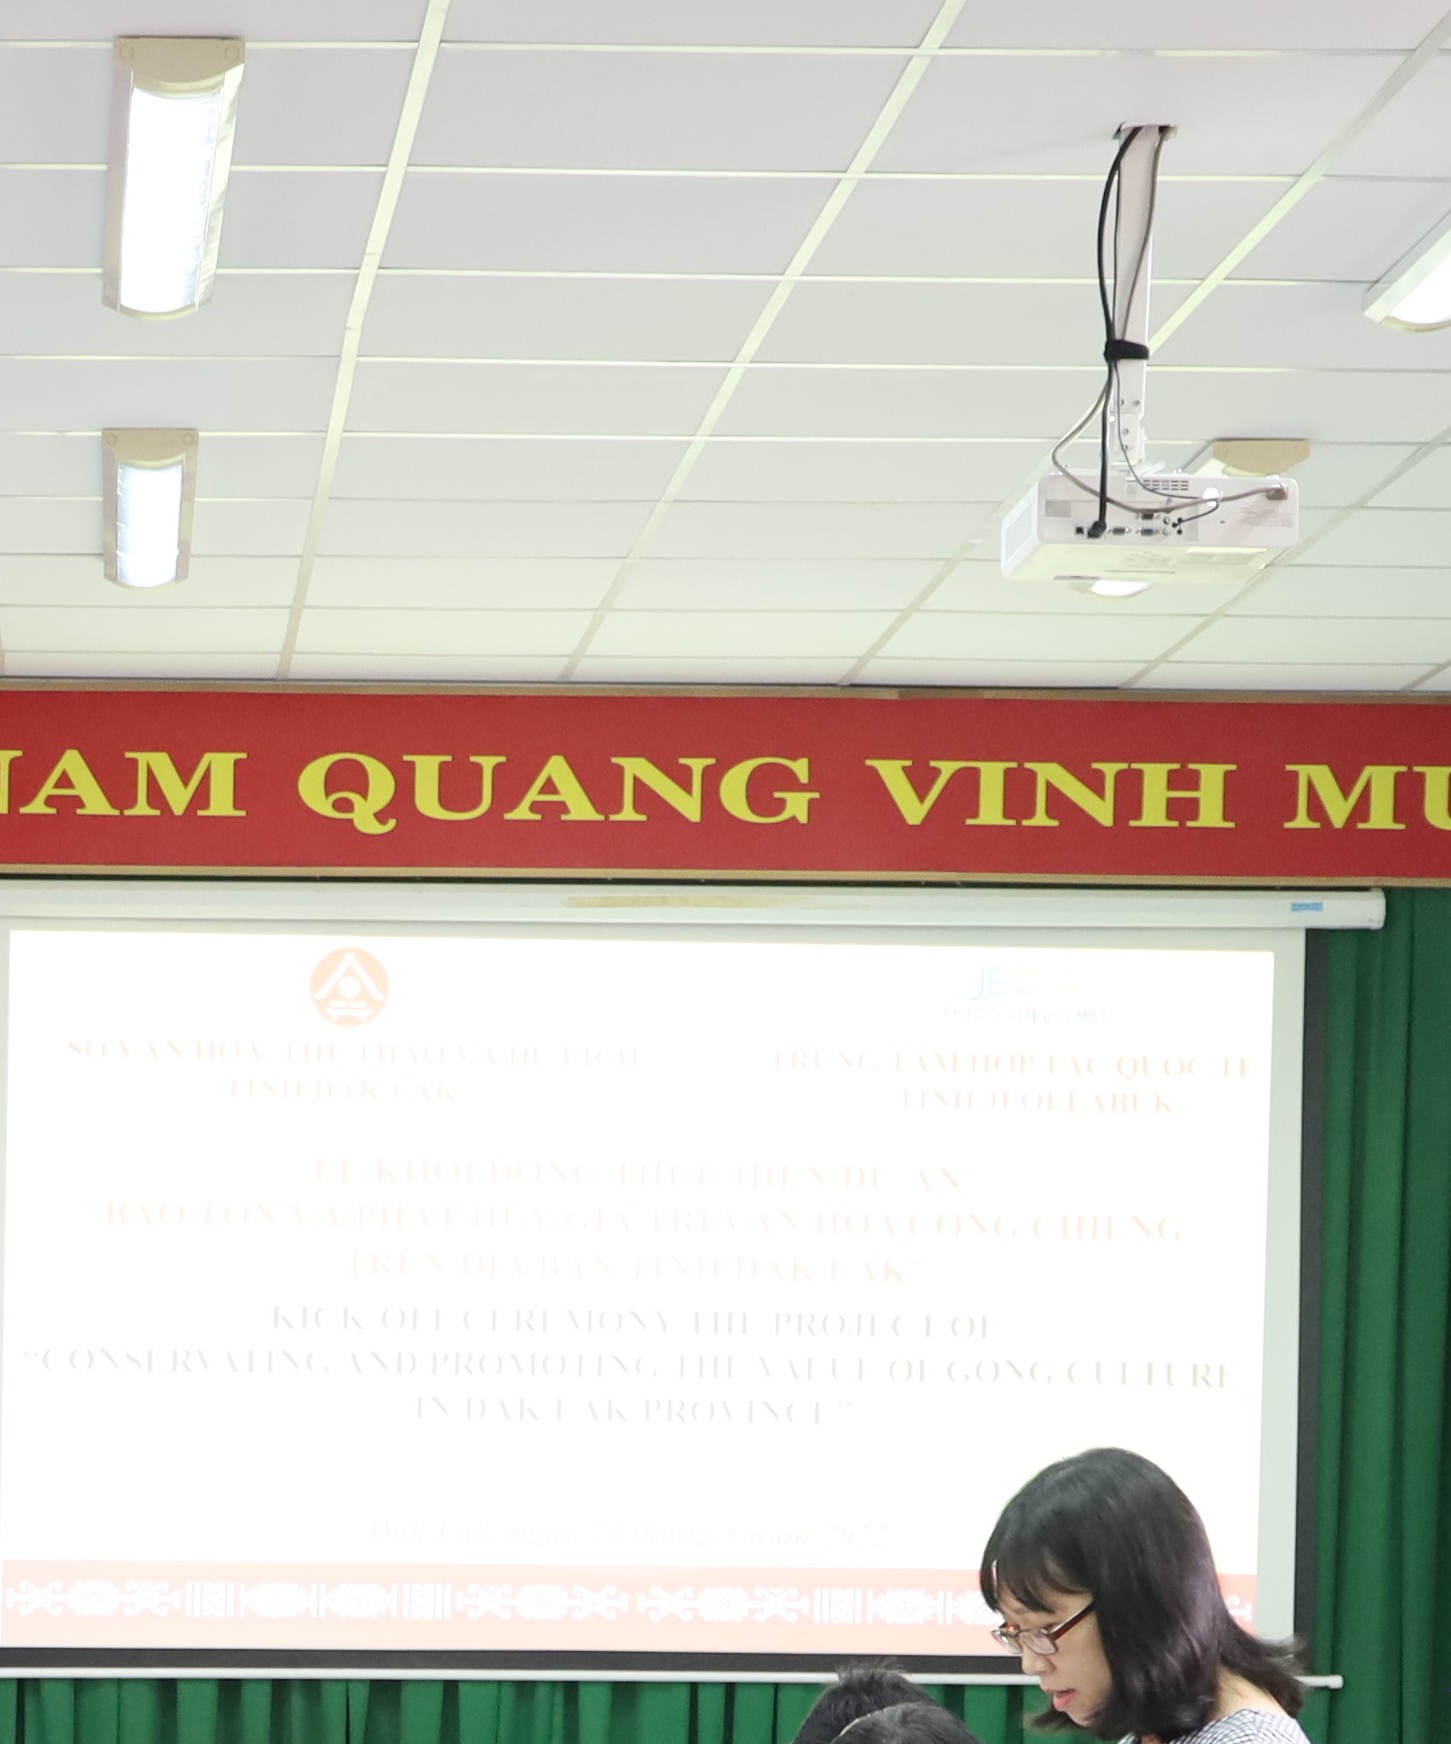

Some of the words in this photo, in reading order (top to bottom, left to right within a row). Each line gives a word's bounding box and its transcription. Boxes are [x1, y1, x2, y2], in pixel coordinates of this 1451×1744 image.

[296, 751, 822, 836] QUANG
[864, 758, 1239, 829] VINH
[348, 1350, 419, 1377] AND
[1064, 1360, 1238, 1391] CULTURE
